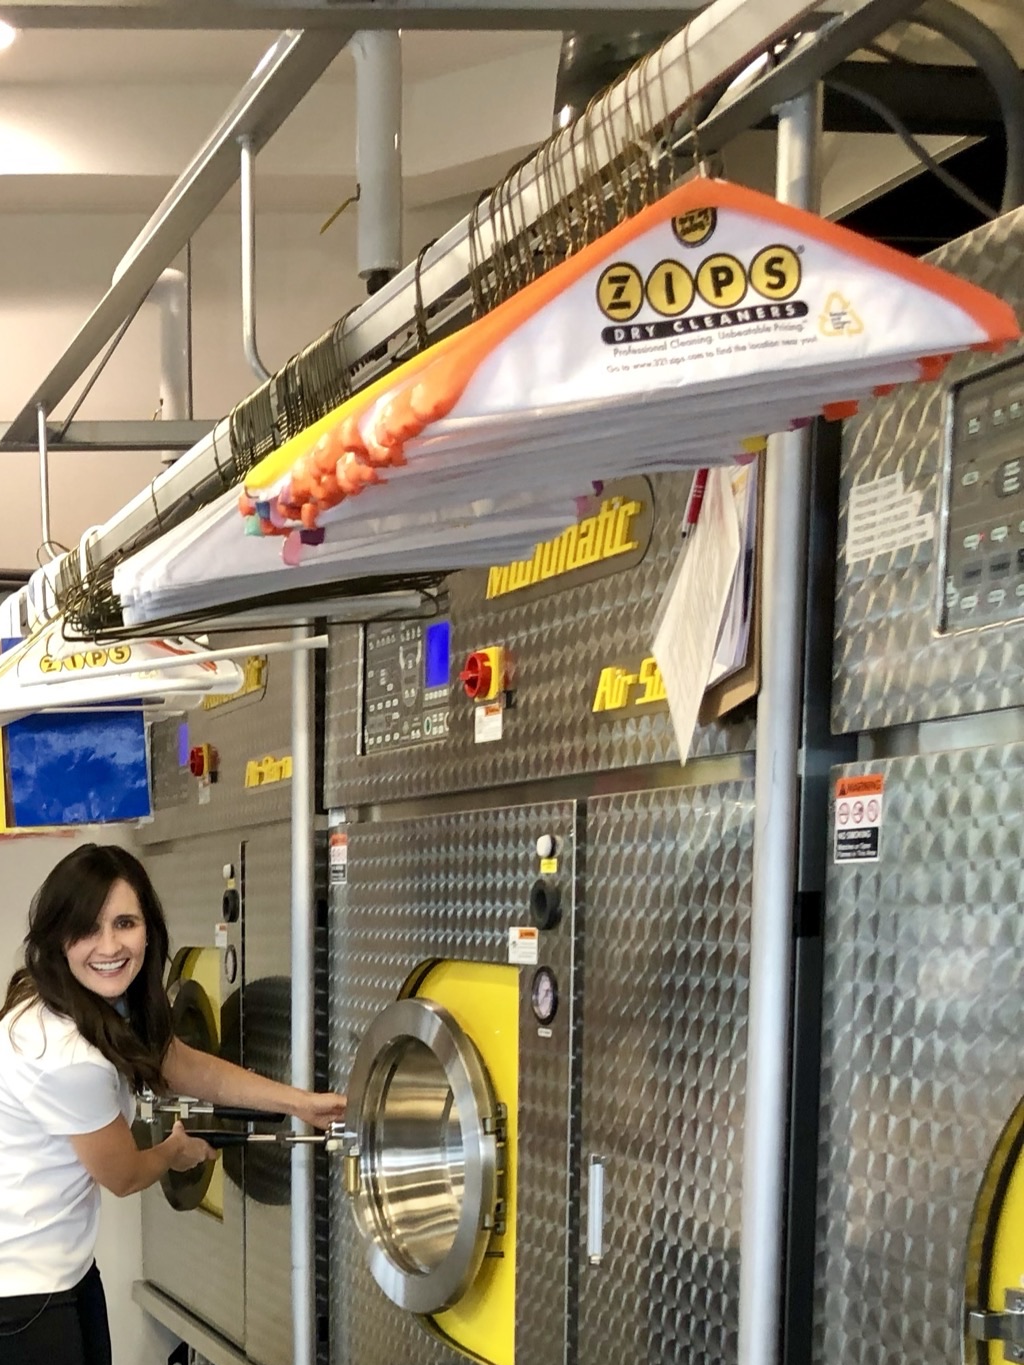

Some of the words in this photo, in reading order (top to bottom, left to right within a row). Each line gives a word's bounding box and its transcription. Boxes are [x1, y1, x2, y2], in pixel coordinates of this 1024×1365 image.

[602, 250, 794, 316] ZIPS
[614, 324, 655, 342] DRY
[673, 304, 796, 331] CLEANERS
[614, 341, 667, 357] Professional
[42, 646, 128, 673] ZIPS
